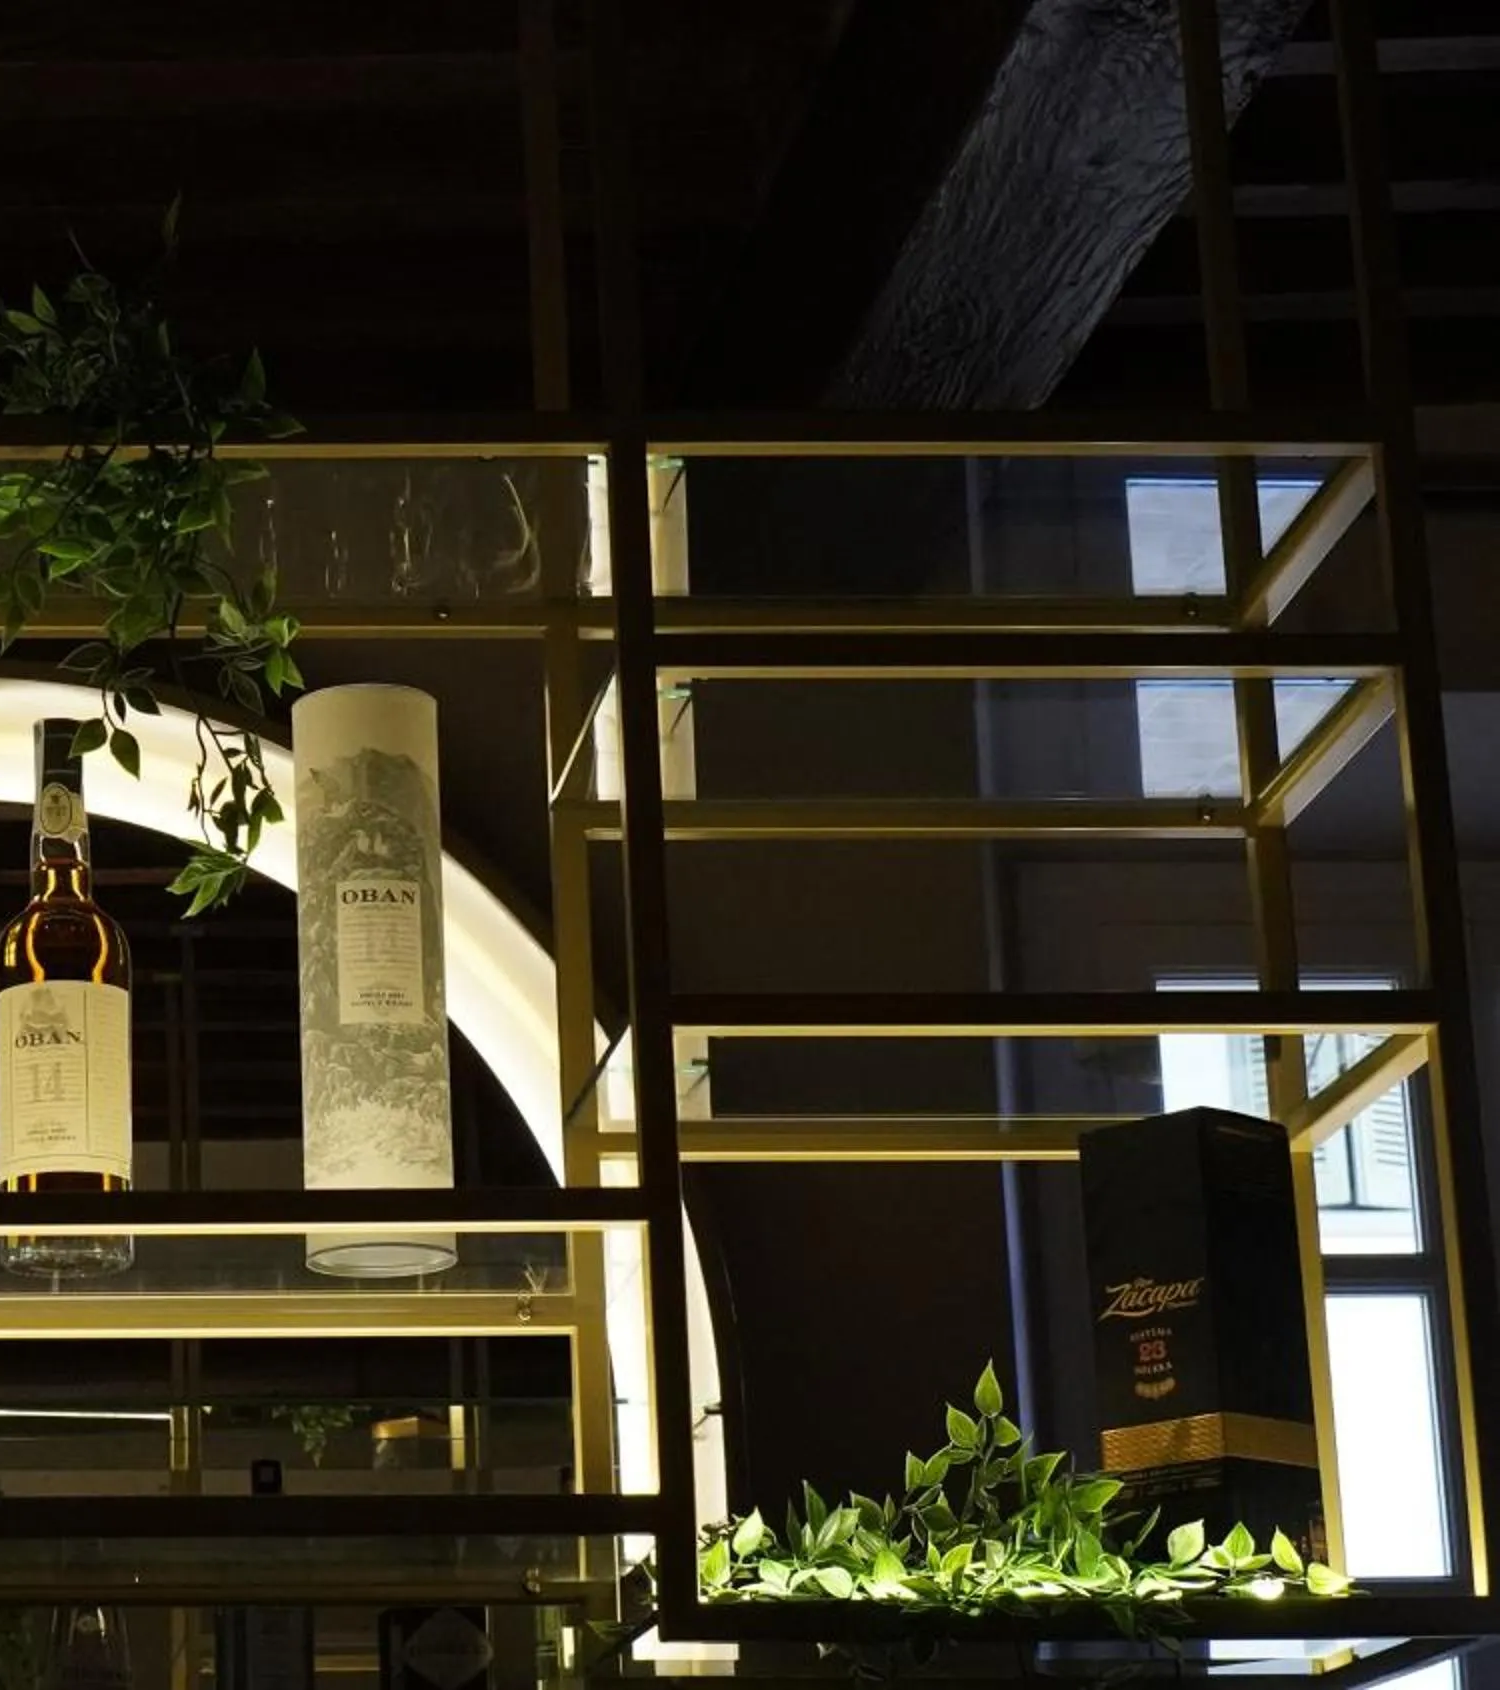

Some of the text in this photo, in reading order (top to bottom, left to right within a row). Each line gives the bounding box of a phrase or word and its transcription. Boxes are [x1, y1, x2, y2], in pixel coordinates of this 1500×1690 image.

[342, 887, 416, 905] OBAN
[15, 1031, 82, 1048] OBAN
[1098, 1277, 1204, 1320] Zacapa
[1140, 1340, 1167, 1361] 23
